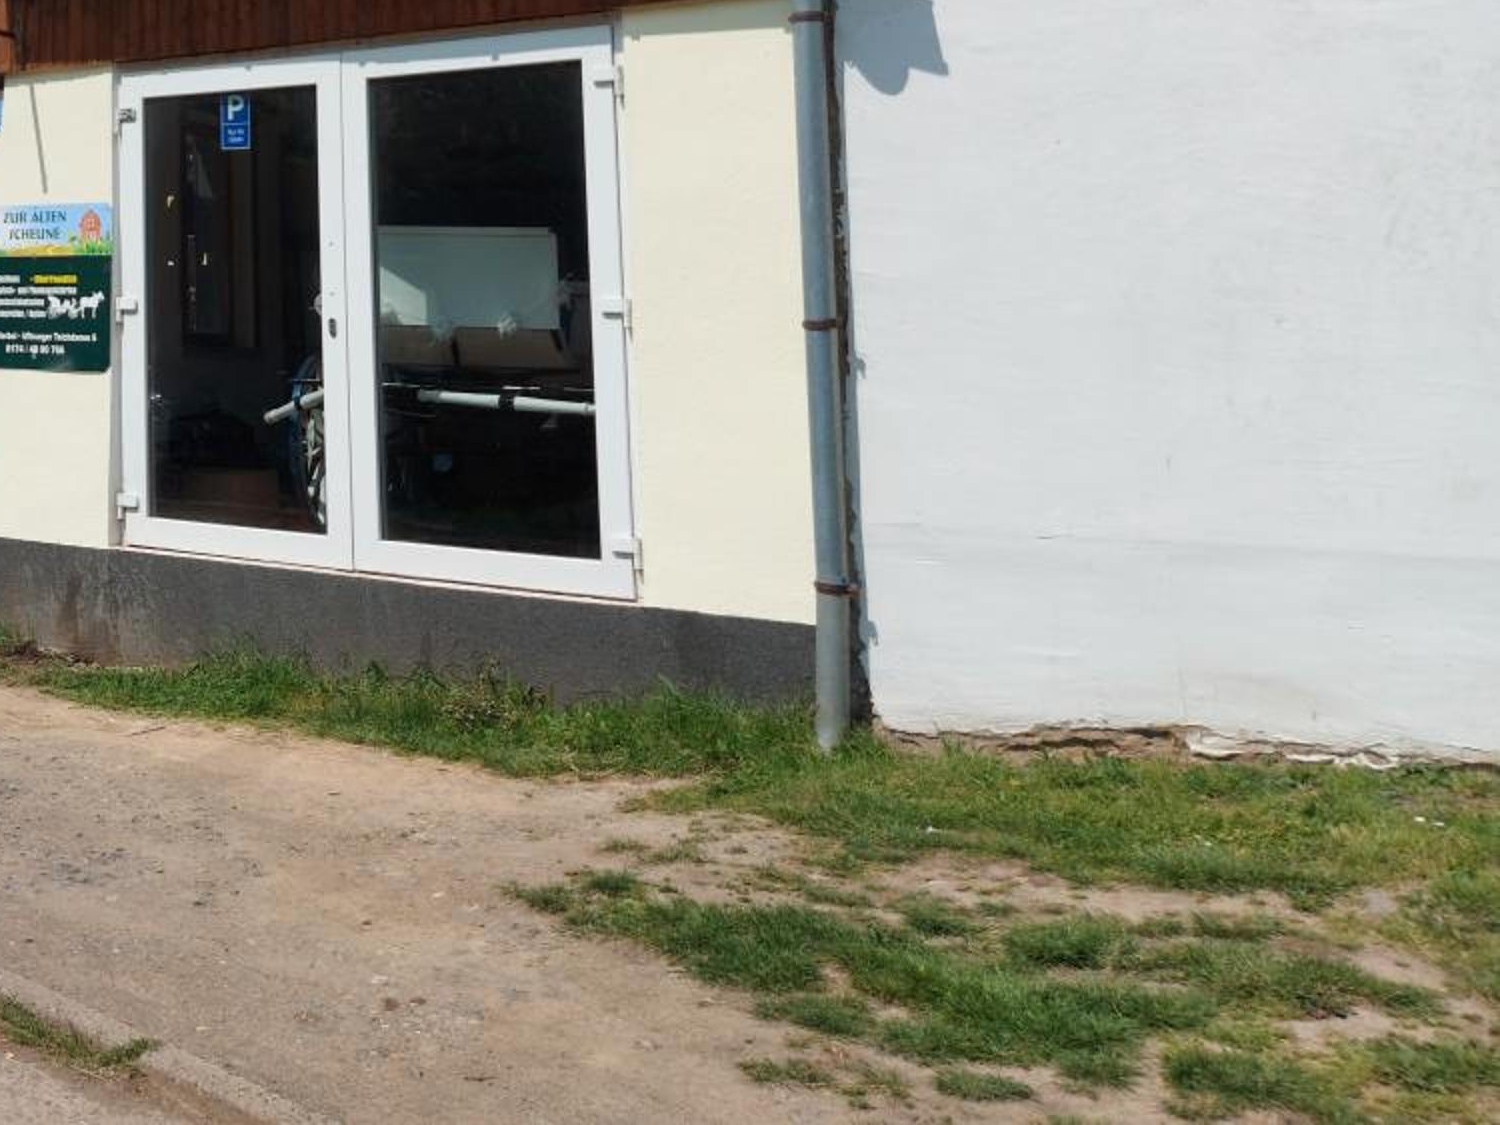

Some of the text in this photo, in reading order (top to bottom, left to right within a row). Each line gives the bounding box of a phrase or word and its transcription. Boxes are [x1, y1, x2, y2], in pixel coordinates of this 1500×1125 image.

[228, 95, 244, 121] P
[3, 210, 67, 224] ZUR ALTEN
[9, 227, 61, 240] SCHEUNE
